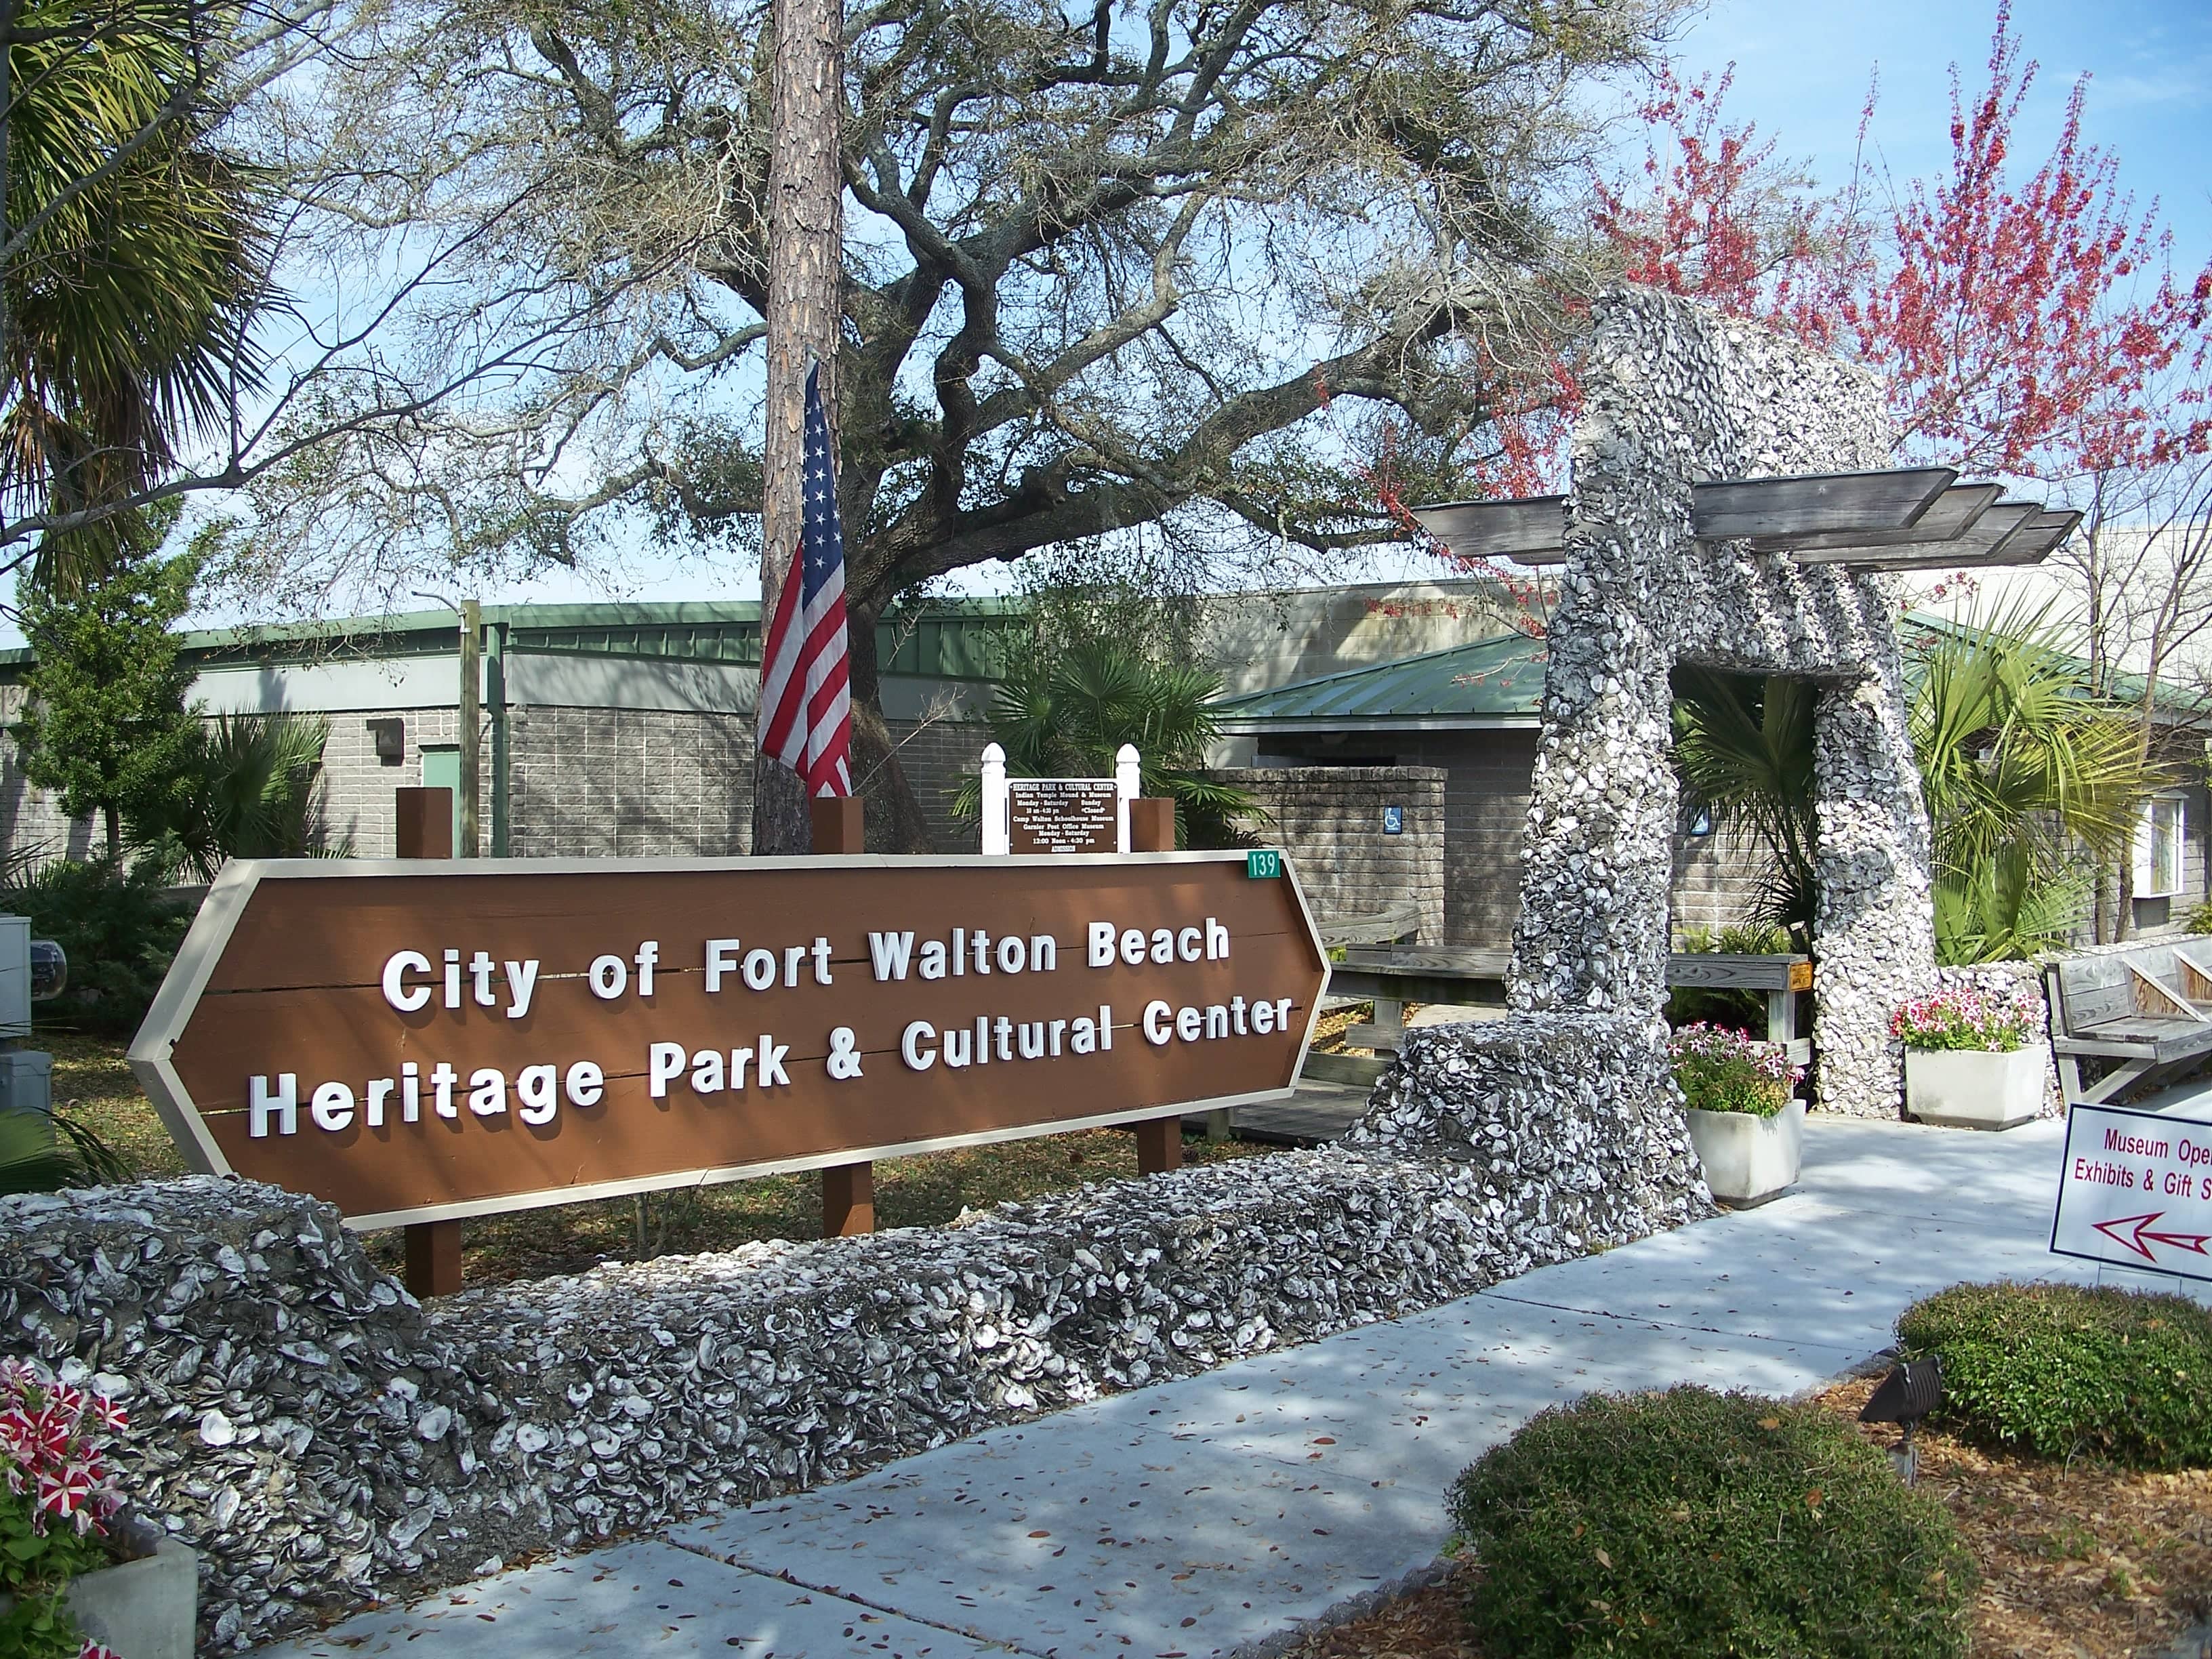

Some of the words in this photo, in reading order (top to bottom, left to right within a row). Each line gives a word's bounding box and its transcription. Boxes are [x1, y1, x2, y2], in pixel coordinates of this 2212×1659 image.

[1036, 792, 1057, 800] Temple
[1081, 799, 1101, 807] Sunday
[1012, 815, 1029, 823] Camp
[1065, 830, 1090, 838] Saturday
[1252, 853, 1275, 876] 139
[382, 949, 539, 1018] City
[589, 941, 659, 1000] of
[705, 938, 834, 993] Fort
[868, 928, 1056, 981] Walton
[1088, 918, 1230, 967] Beach
[249, 1061, 604, 1138] Heritage
[650, 1034, 791, 1098] Park
[826, 1027, 863, 1080] &
[901, 1005, 1112, 1071] Cultural
[1143, 996, 1292, 1046] Center
[2104, 1128, 2169, 1158] Museum
[2178, 1139, 2212, 1168] Ope
[2074, 1158, 2134, 1188] Exhibits
[2143, 1168, 2154, 1191] &
[2164, 1172, 2192, 1197] Gift
[2200, 1177, 2212, 1200] S
